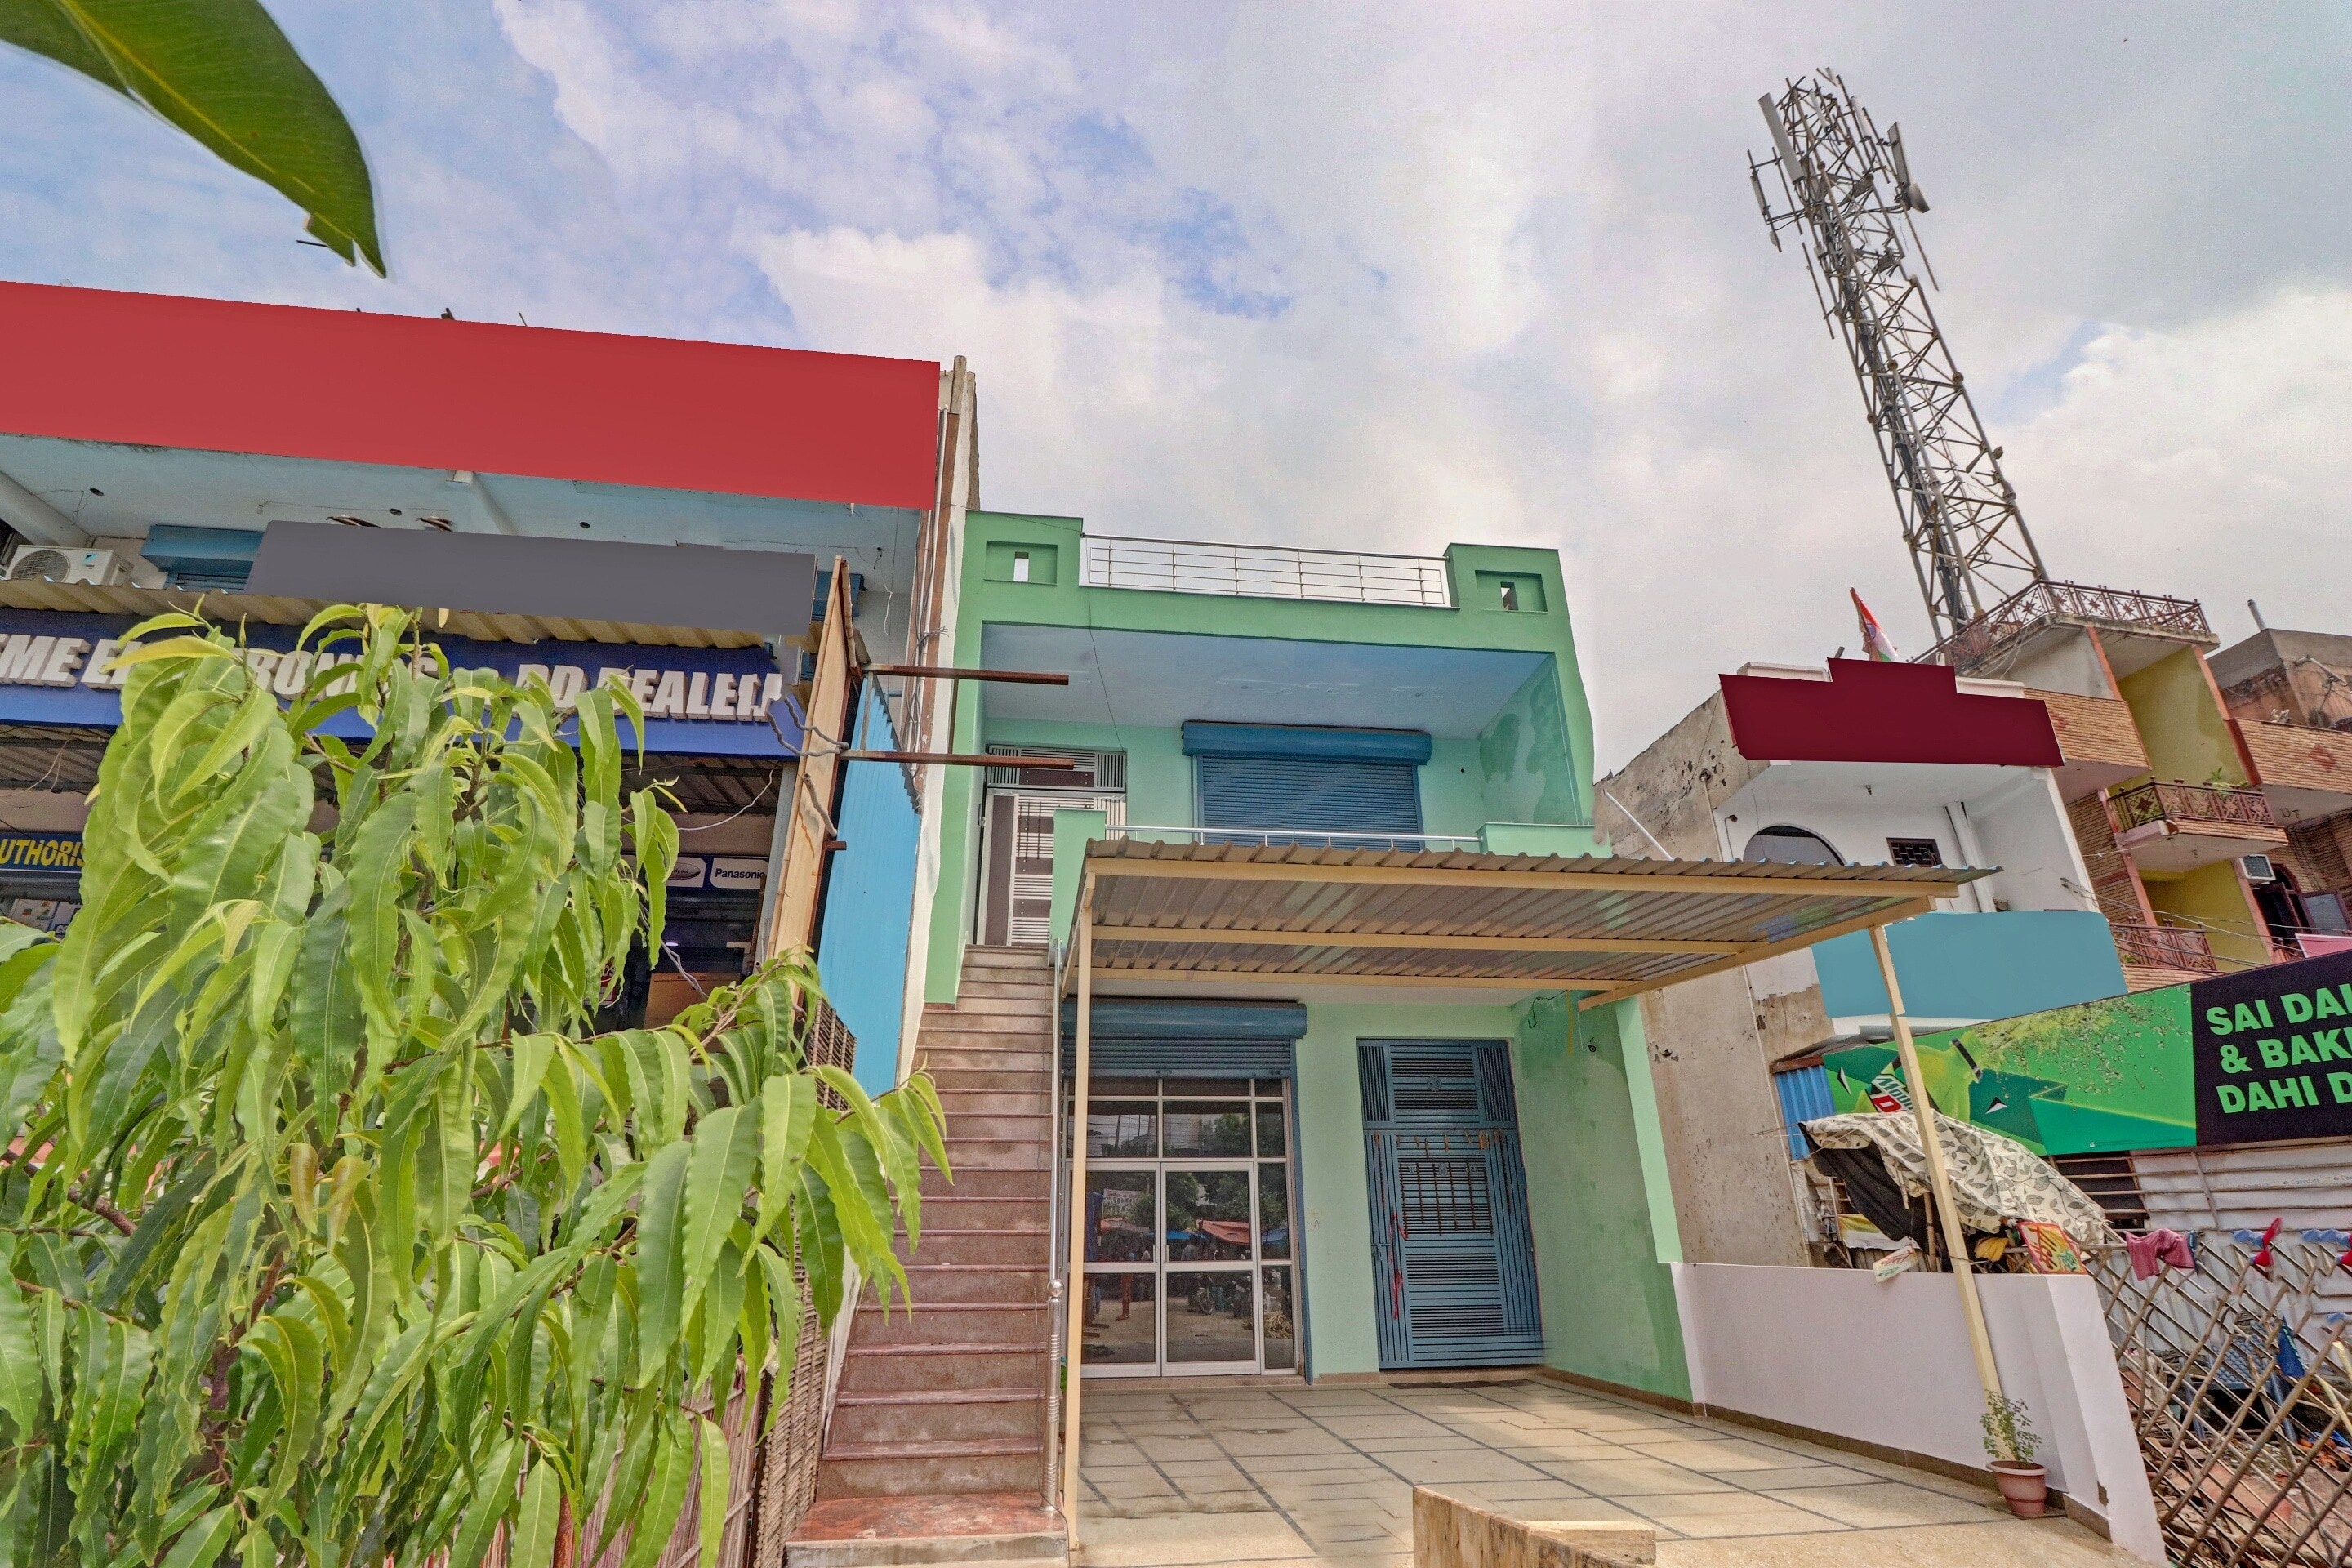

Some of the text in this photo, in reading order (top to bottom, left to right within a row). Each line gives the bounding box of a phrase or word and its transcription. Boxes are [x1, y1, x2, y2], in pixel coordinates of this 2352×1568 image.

[0, 634, 90, 686] ME
[0, 839, 84, 867] UTHORI
[2206, 999, 2274, 1035] SAI
[2220, 1045, 2252, 1074] &
[2216, 1076, 2319, 1113] DAHI
